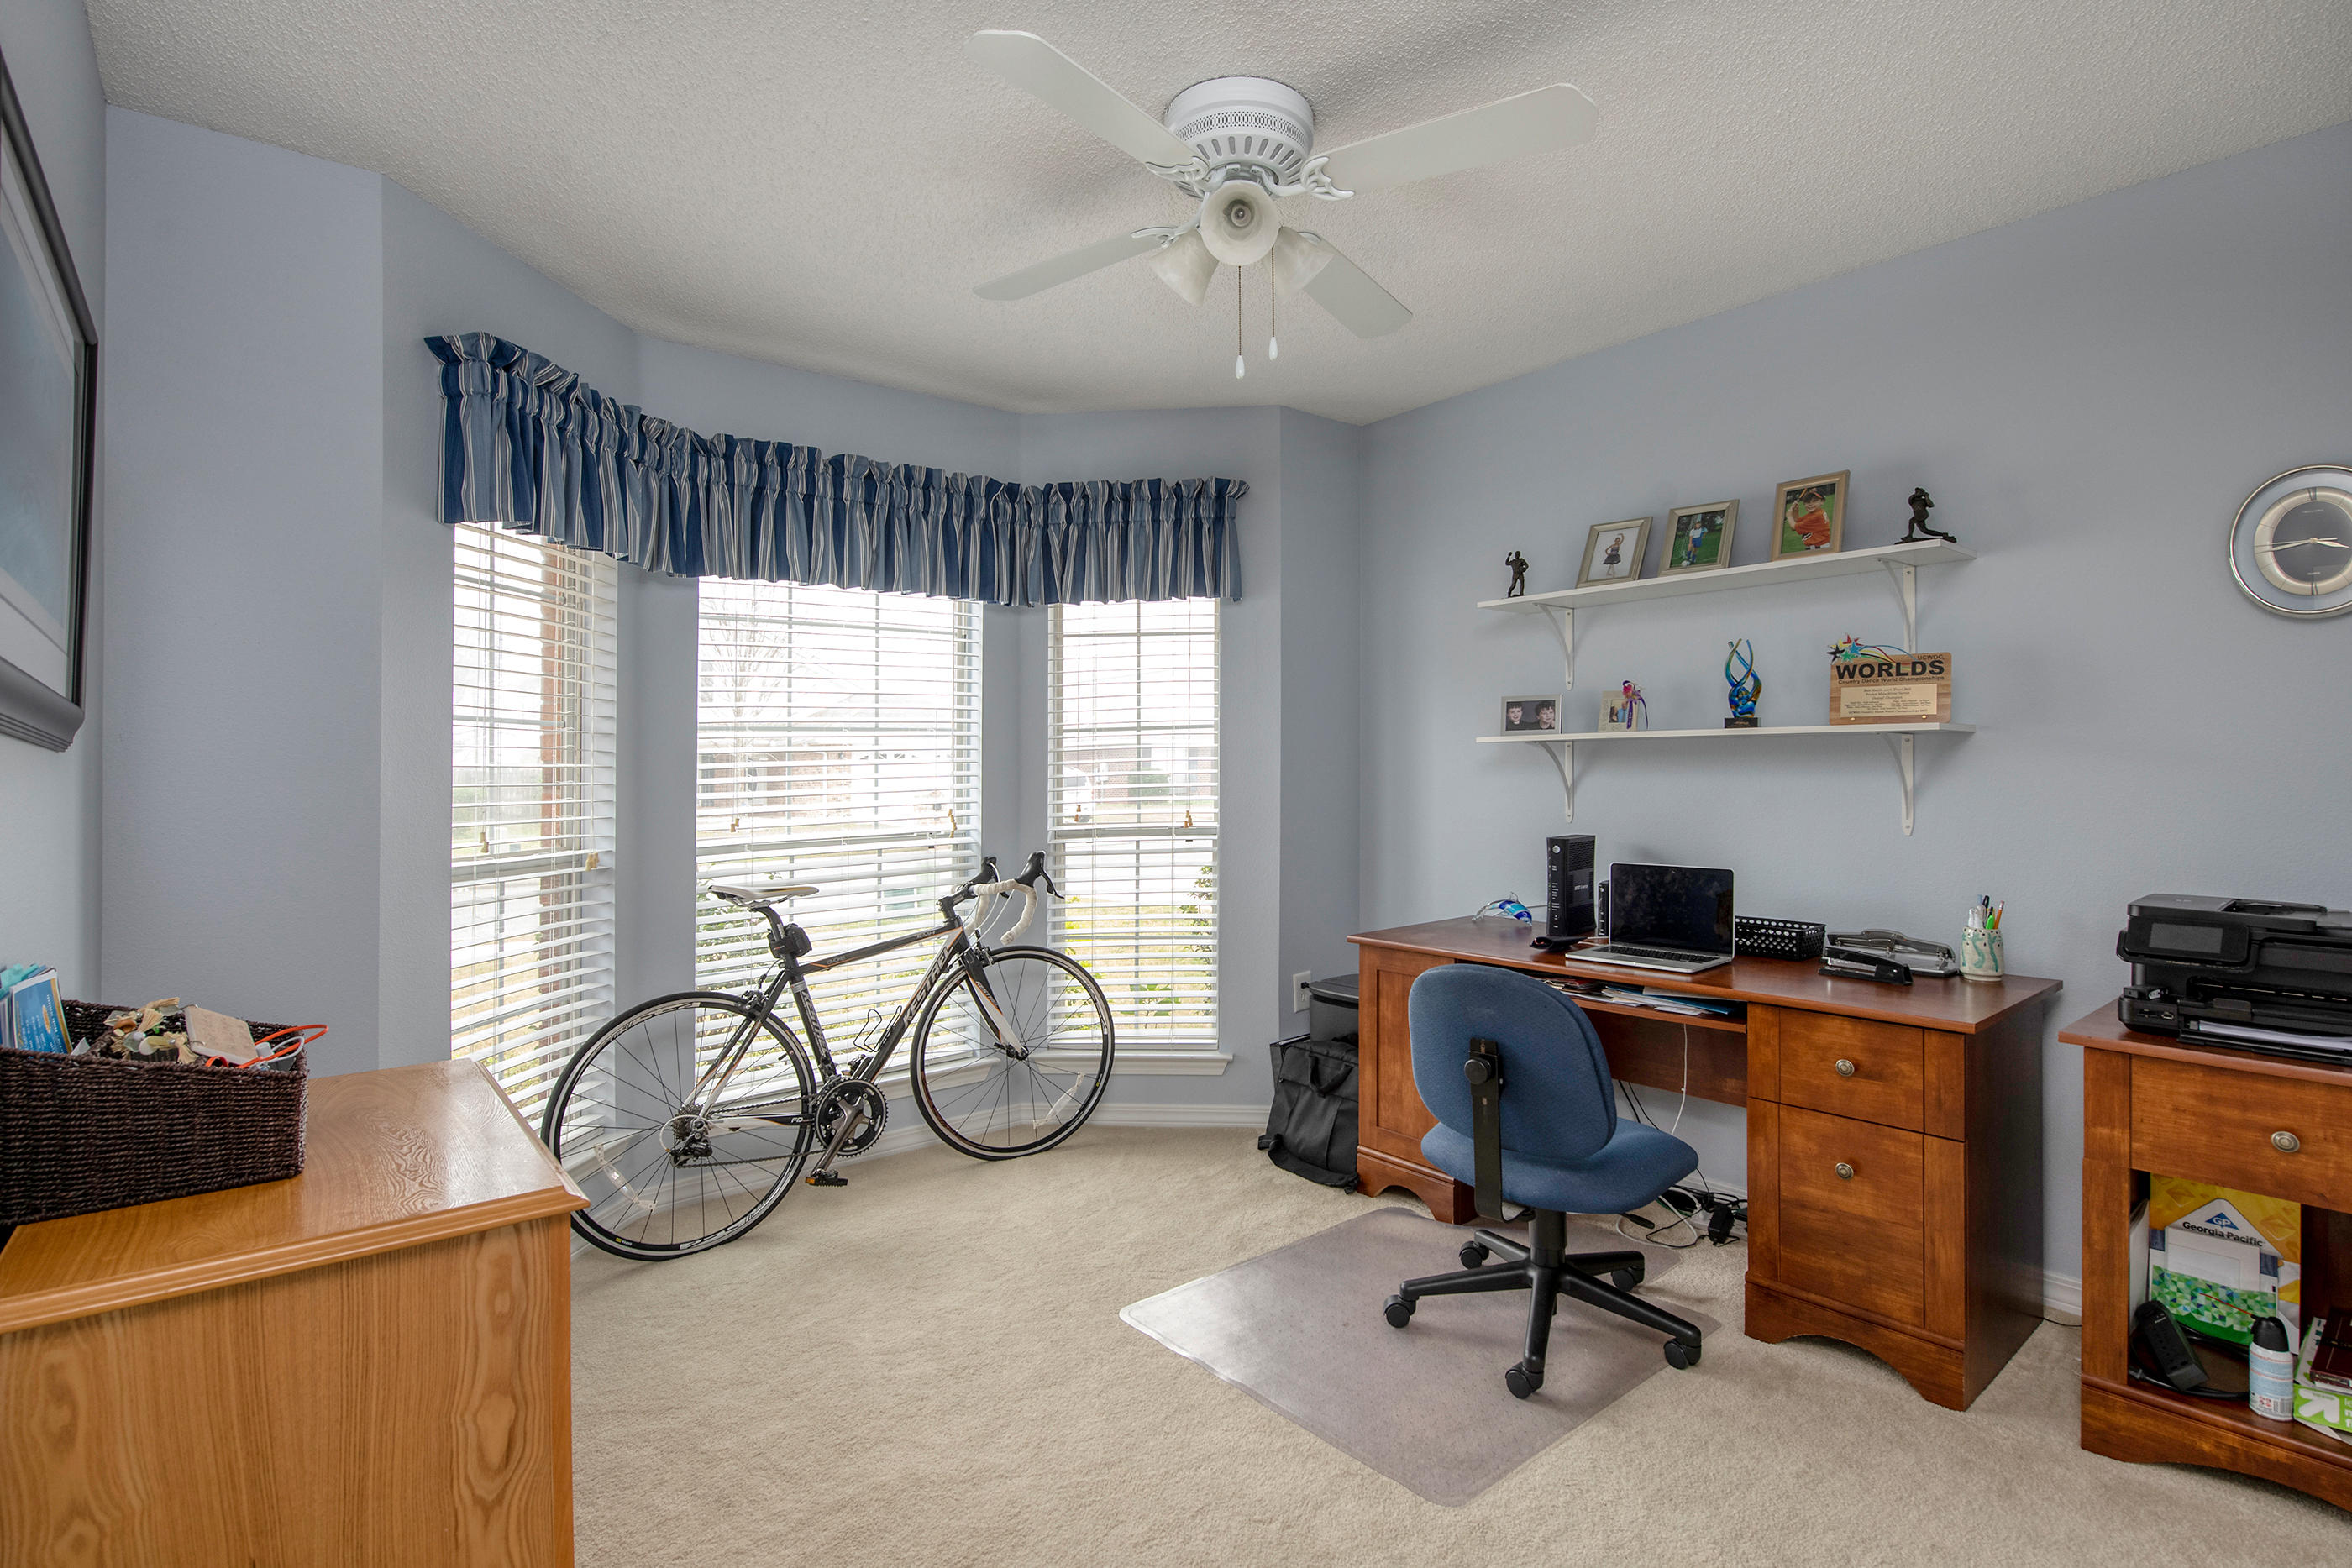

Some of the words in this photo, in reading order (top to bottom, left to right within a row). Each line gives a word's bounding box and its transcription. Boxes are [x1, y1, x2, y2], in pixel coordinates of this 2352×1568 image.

[1836, 660, 1945, 679] WORLDS
[903, 946, 954, 1028] KESTREL
[2213, 1217, 2232, 1226] GP
[2182, 1221, 2263, 1247] Georgia-Pacific
